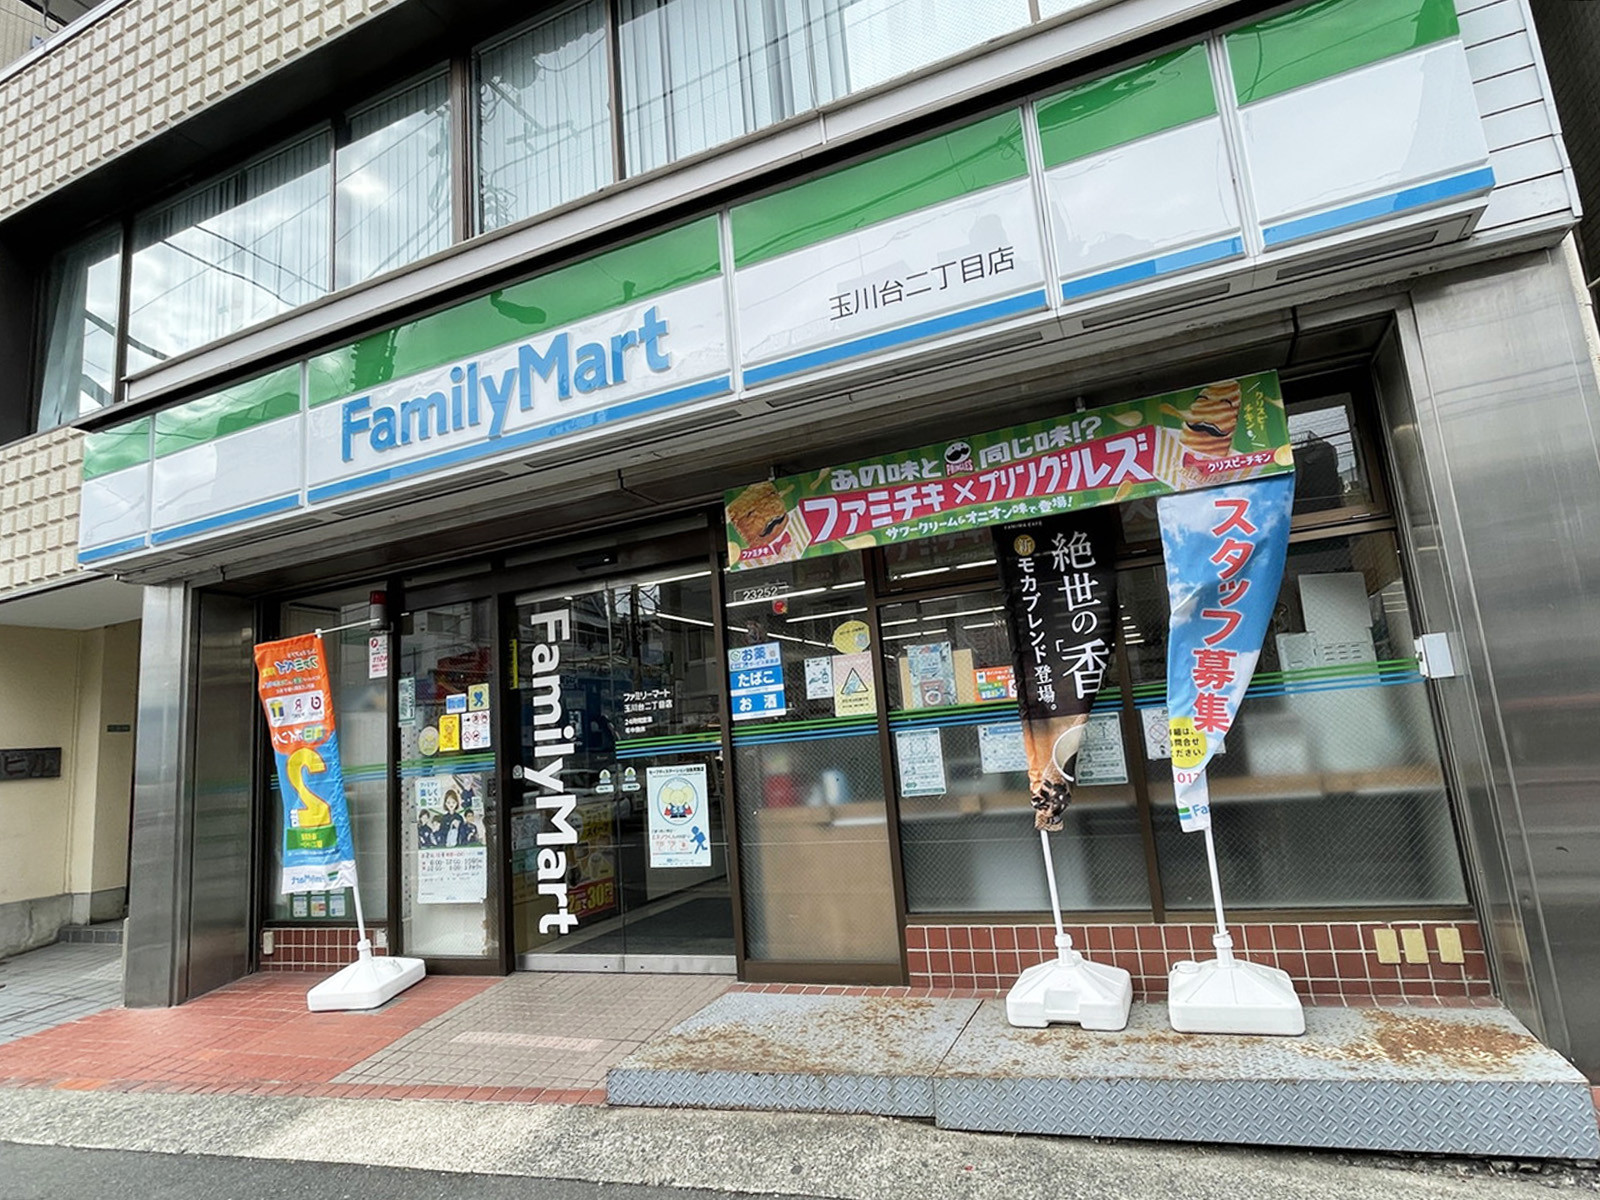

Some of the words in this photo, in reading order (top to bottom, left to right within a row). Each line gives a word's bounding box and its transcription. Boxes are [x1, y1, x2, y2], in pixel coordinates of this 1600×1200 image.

[829, 246, 1014, 321] 玉川台二丁目店
[342, 305, 671, 463] FamilyMart
[830, 457, 942, 491] あの味と
[979, 416, 1102, 469] 同じ味!?
[1208, 453, 1271, 475] クリスピーチキン
[742, 546, 770, 559] ファミチキ
[743, 586, 778, 600] 23252
[1191, 498, 1258, 733] スタッフ募集
[741, 646, 766, 662] お薬
[738, 670, 775, 687] たばこ
[623, 688, 671, 702] ファミリーマート
[523, 608, 579, 934] FamilyMart
